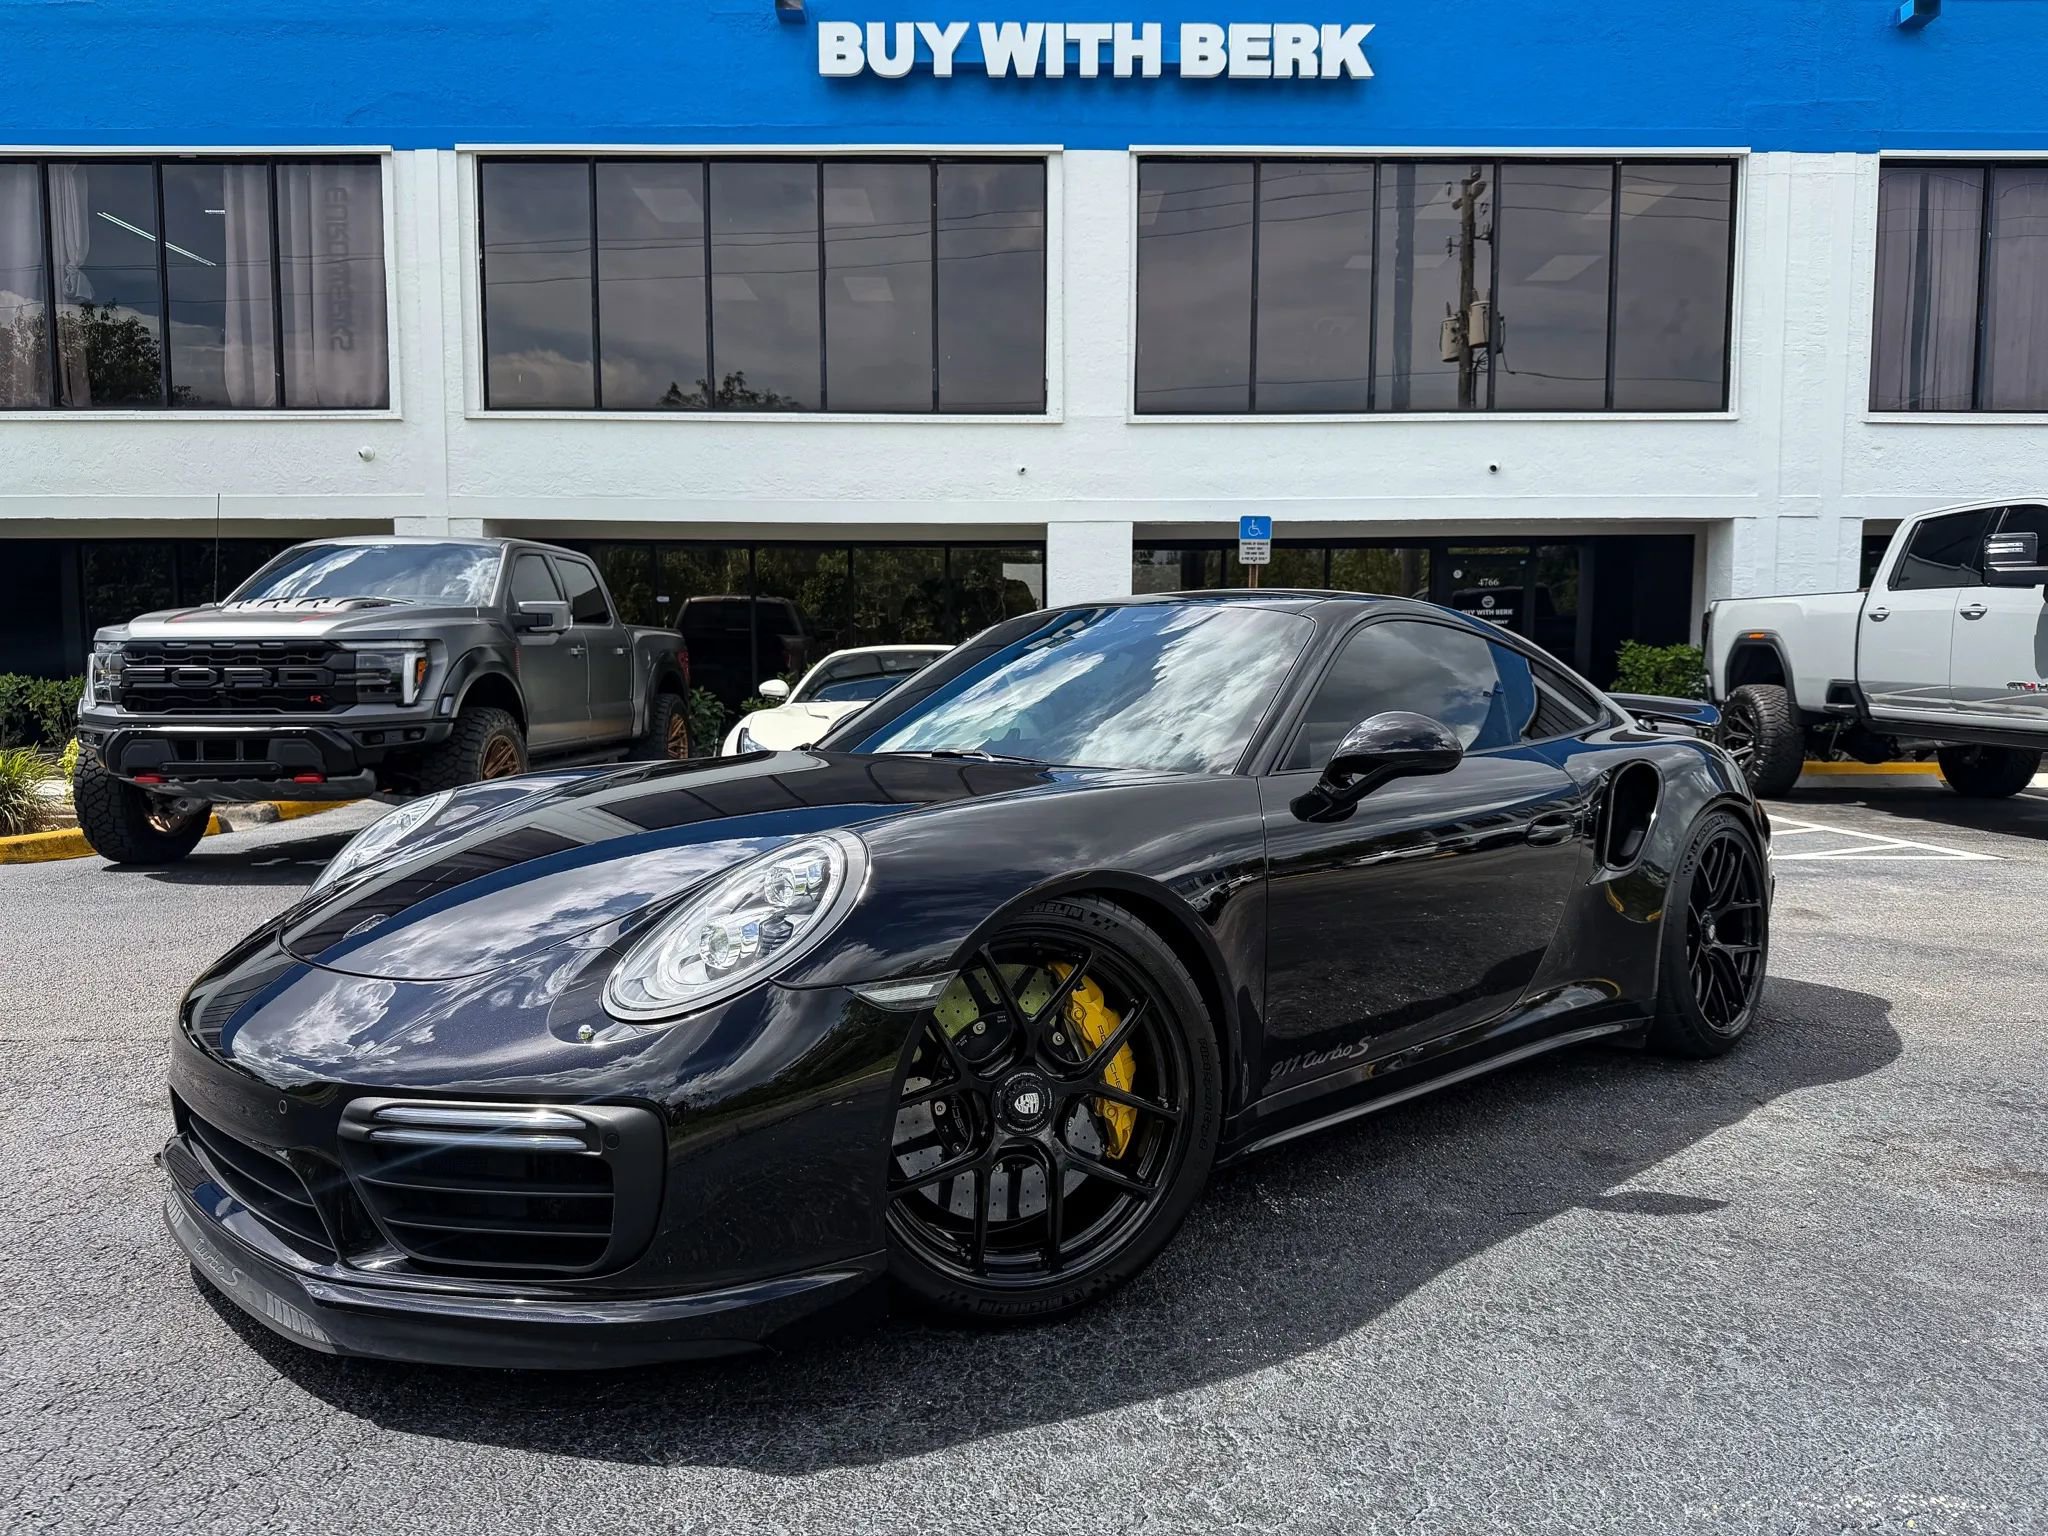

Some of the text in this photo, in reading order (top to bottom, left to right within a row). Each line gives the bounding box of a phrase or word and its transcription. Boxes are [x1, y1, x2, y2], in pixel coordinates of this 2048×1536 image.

[818, 21, 1375, 80] BUY WITH BERK
[1478, 578, 1499, 586] 4766
[1495, 608, 1513, 616] BERK
[121, 667, 336, 688] FORD
[309, 694, 324, 703] R
[1032, 902, 1085, 920] HELIN
[1270, 1054, 1301, 1081] 911
[1349, 1035, 1371, 1059] S
[220, 1267, 243, 1287] S
